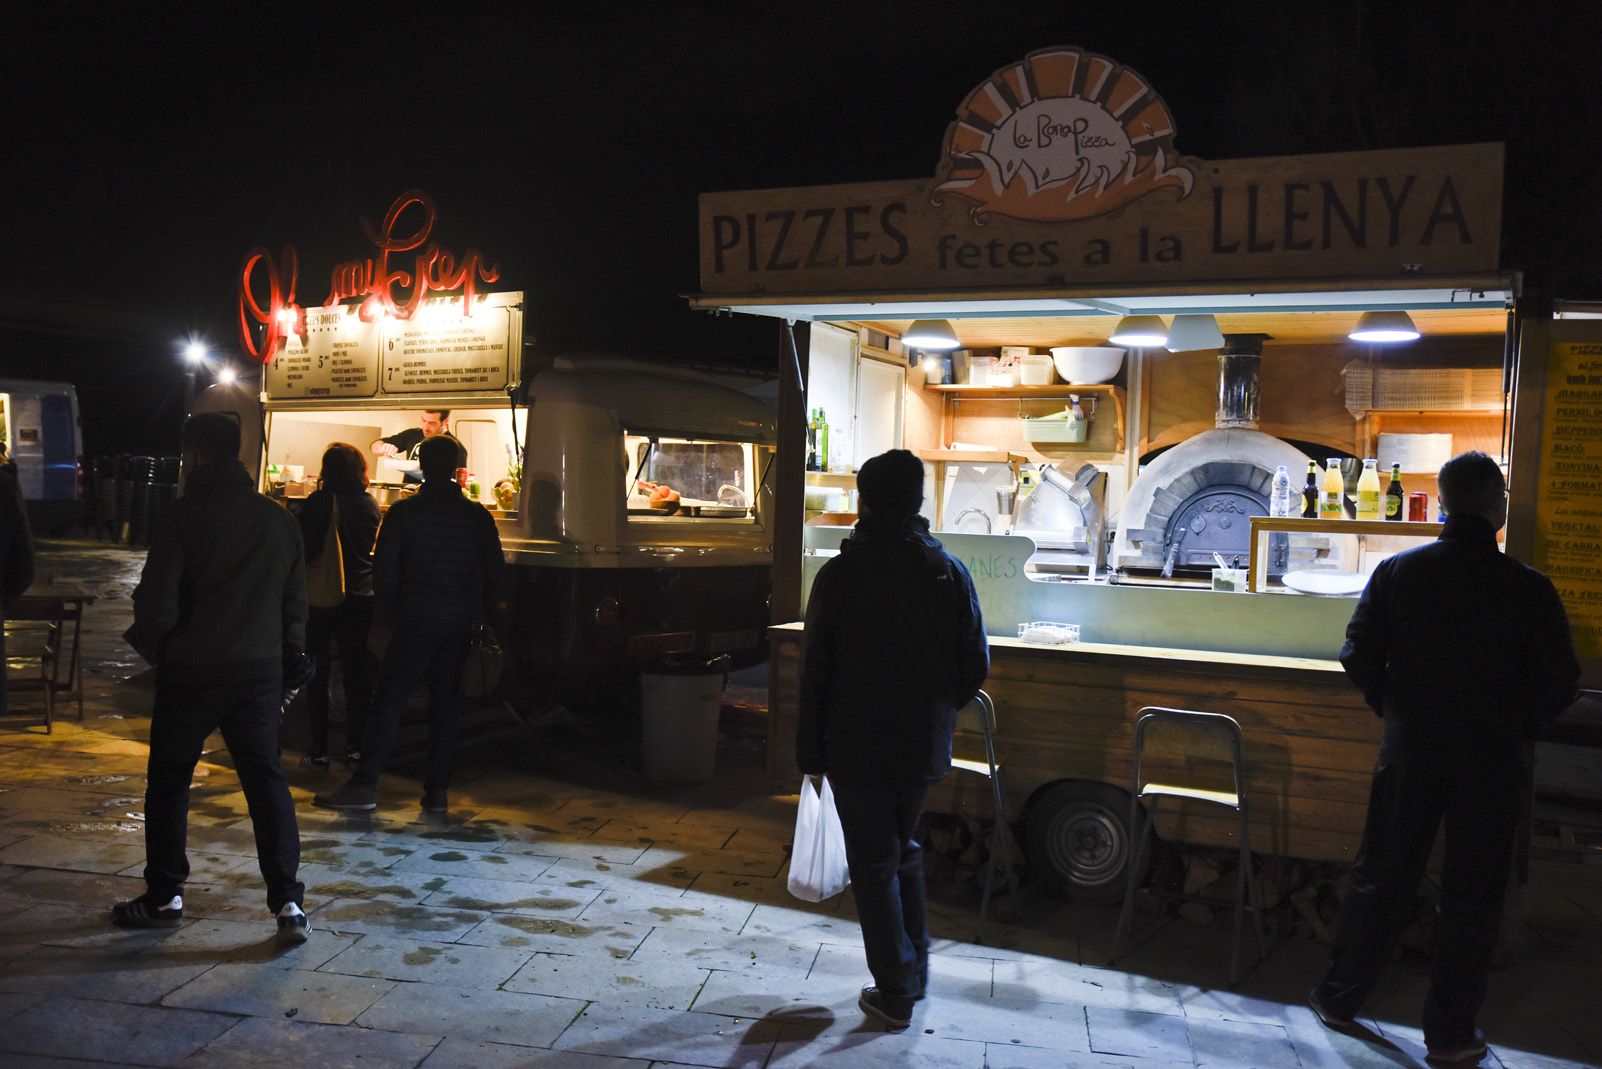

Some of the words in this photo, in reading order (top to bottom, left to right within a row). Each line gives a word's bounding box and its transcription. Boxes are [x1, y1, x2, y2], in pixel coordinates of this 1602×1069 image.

[1013, 119, 1034, 149] La
[713, 202, 909, 274] PIZZES
[938, 233, 1060, 270] fetes
[1084, 237, 1111, 265] a
[1139, 226, 1183, 264] la
[1212, 174, 1474, 255] LLENYA
[388, 337, 394, 351] 6
[318, 355, 324, 369] 5
[387, 367, 394, 381] 7
[969, 553, 1018, 579] ANES
